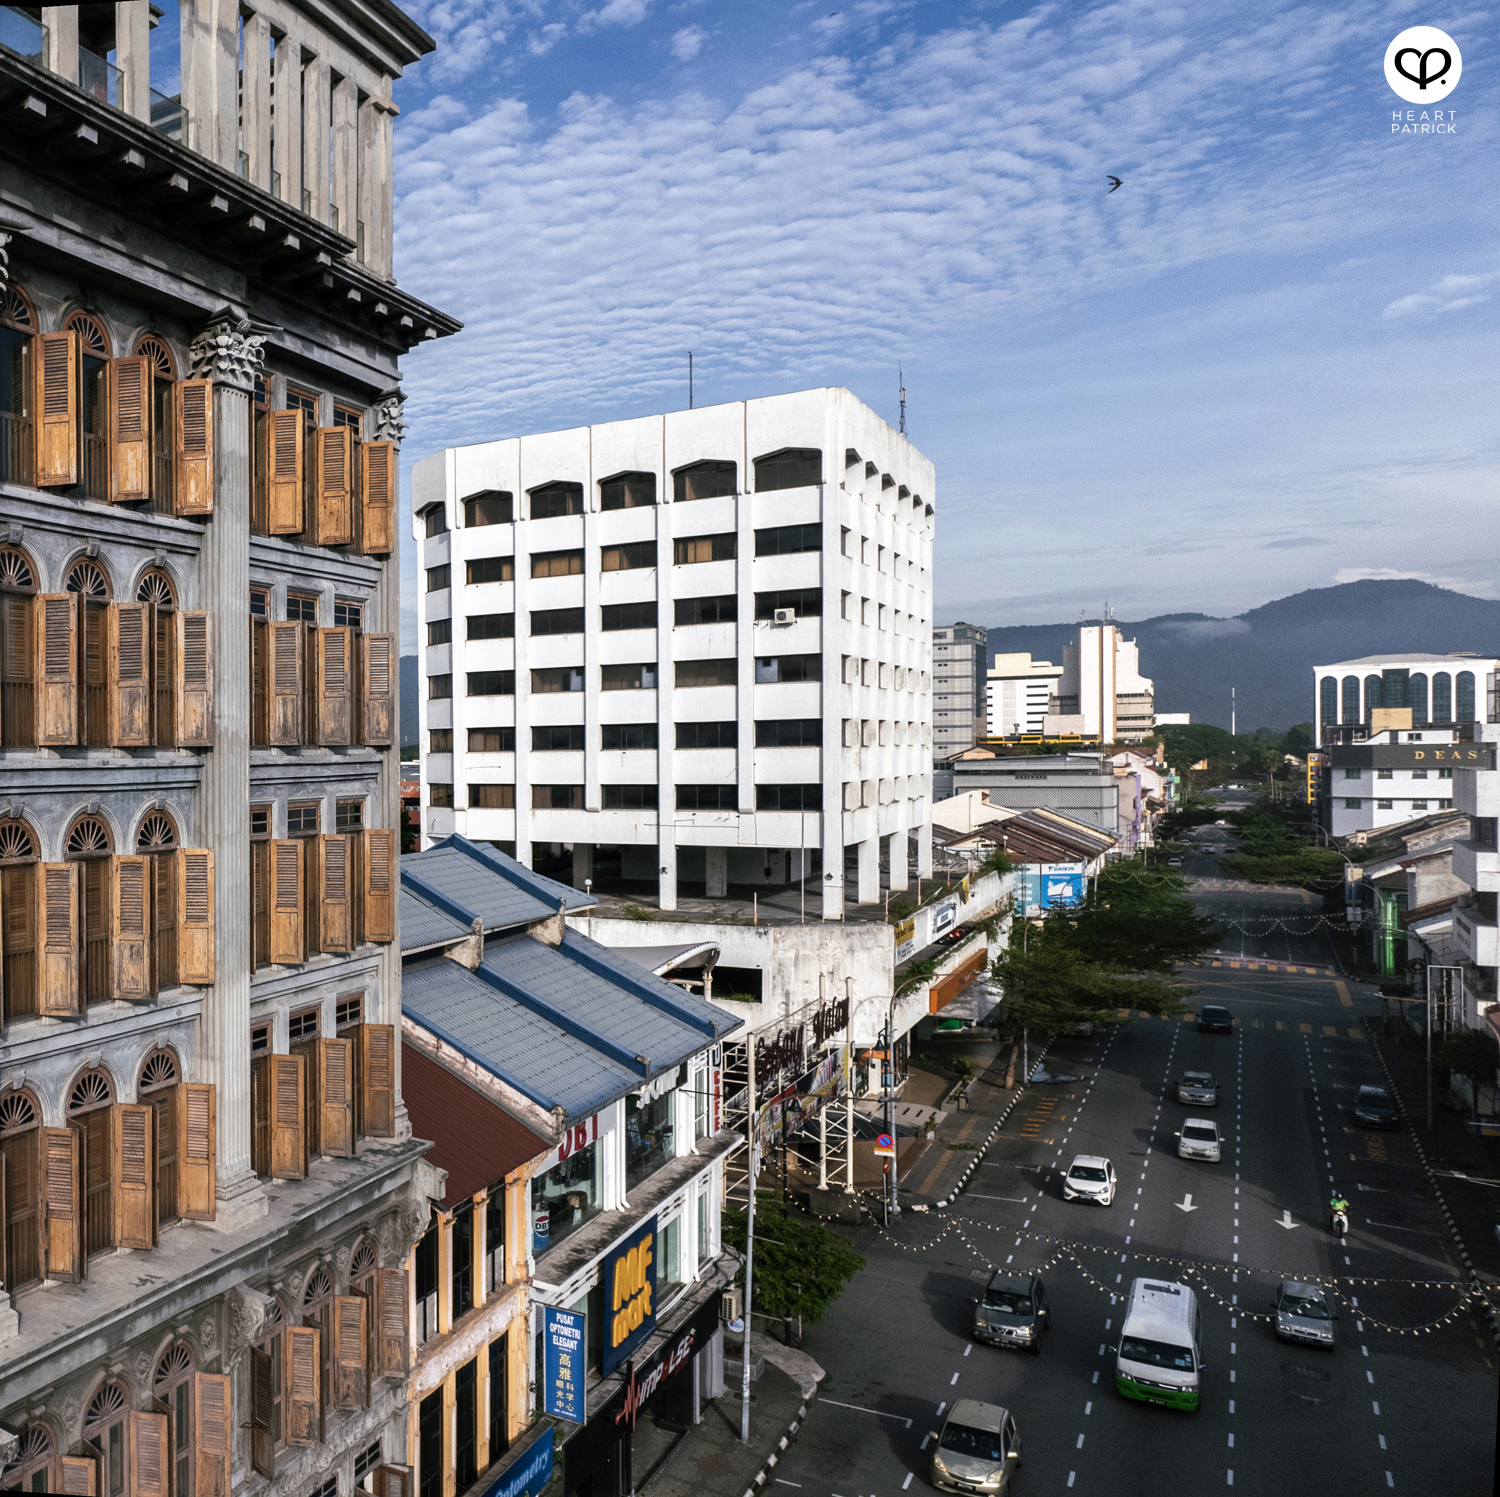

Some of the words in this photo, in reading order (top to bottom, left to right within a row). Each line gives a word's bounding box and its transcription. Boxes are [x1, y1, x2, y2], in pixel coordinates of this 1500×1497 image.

[713, 1070, 721, 1132] CAFE
[556, 1312, 575, 1326] PUSAT
[549, 1322, 581, 1340] OPTOMETRI
[552, 1335, 578, 1350] ELEGANT
[559, 1353, 572, 1381] 高雅
